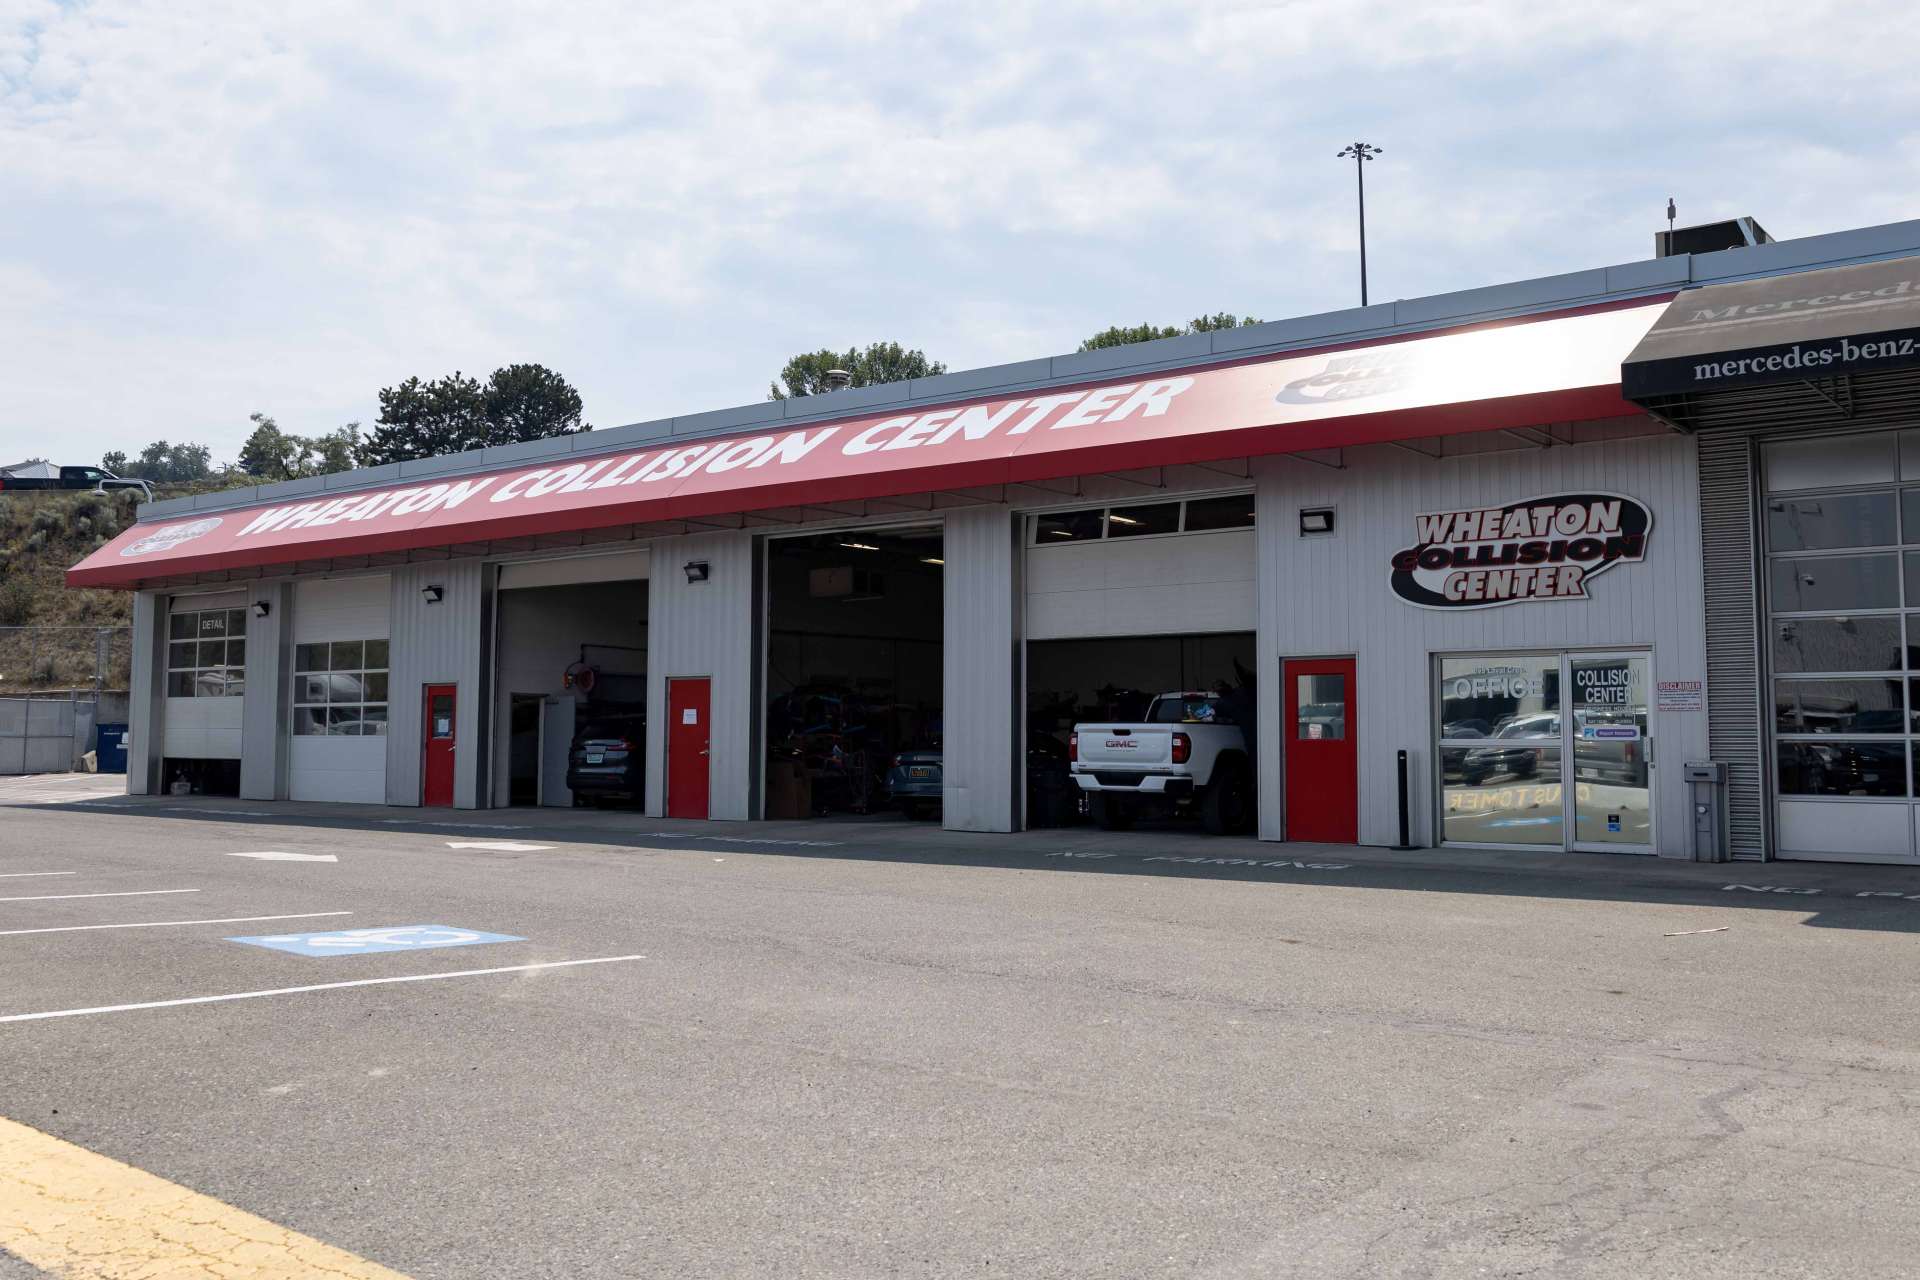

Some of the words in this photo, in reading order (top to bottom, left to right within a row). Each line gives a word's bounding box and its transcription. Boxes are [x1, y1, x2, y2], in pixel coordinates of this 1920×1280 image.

[236, 477, 498, 537] WHEATON
[489, 427, 841, 503] COLLISION
[842, 377, 1195, 456] CENTER
[1416, 501, 1622, 545] WHEATON
[1391, 535, 1646, 572] COLLISION
[1444, 566, 1585, 601] CENTER
[202, 619, 224, 630] DETAIL
[1455, 677, 1545, 699] OFFICE
[1577, 668, 1640, 686] COLLISION
[1585, 686, 1633, 703] CENTER
[1105, 740, 1138, 748] GMC
